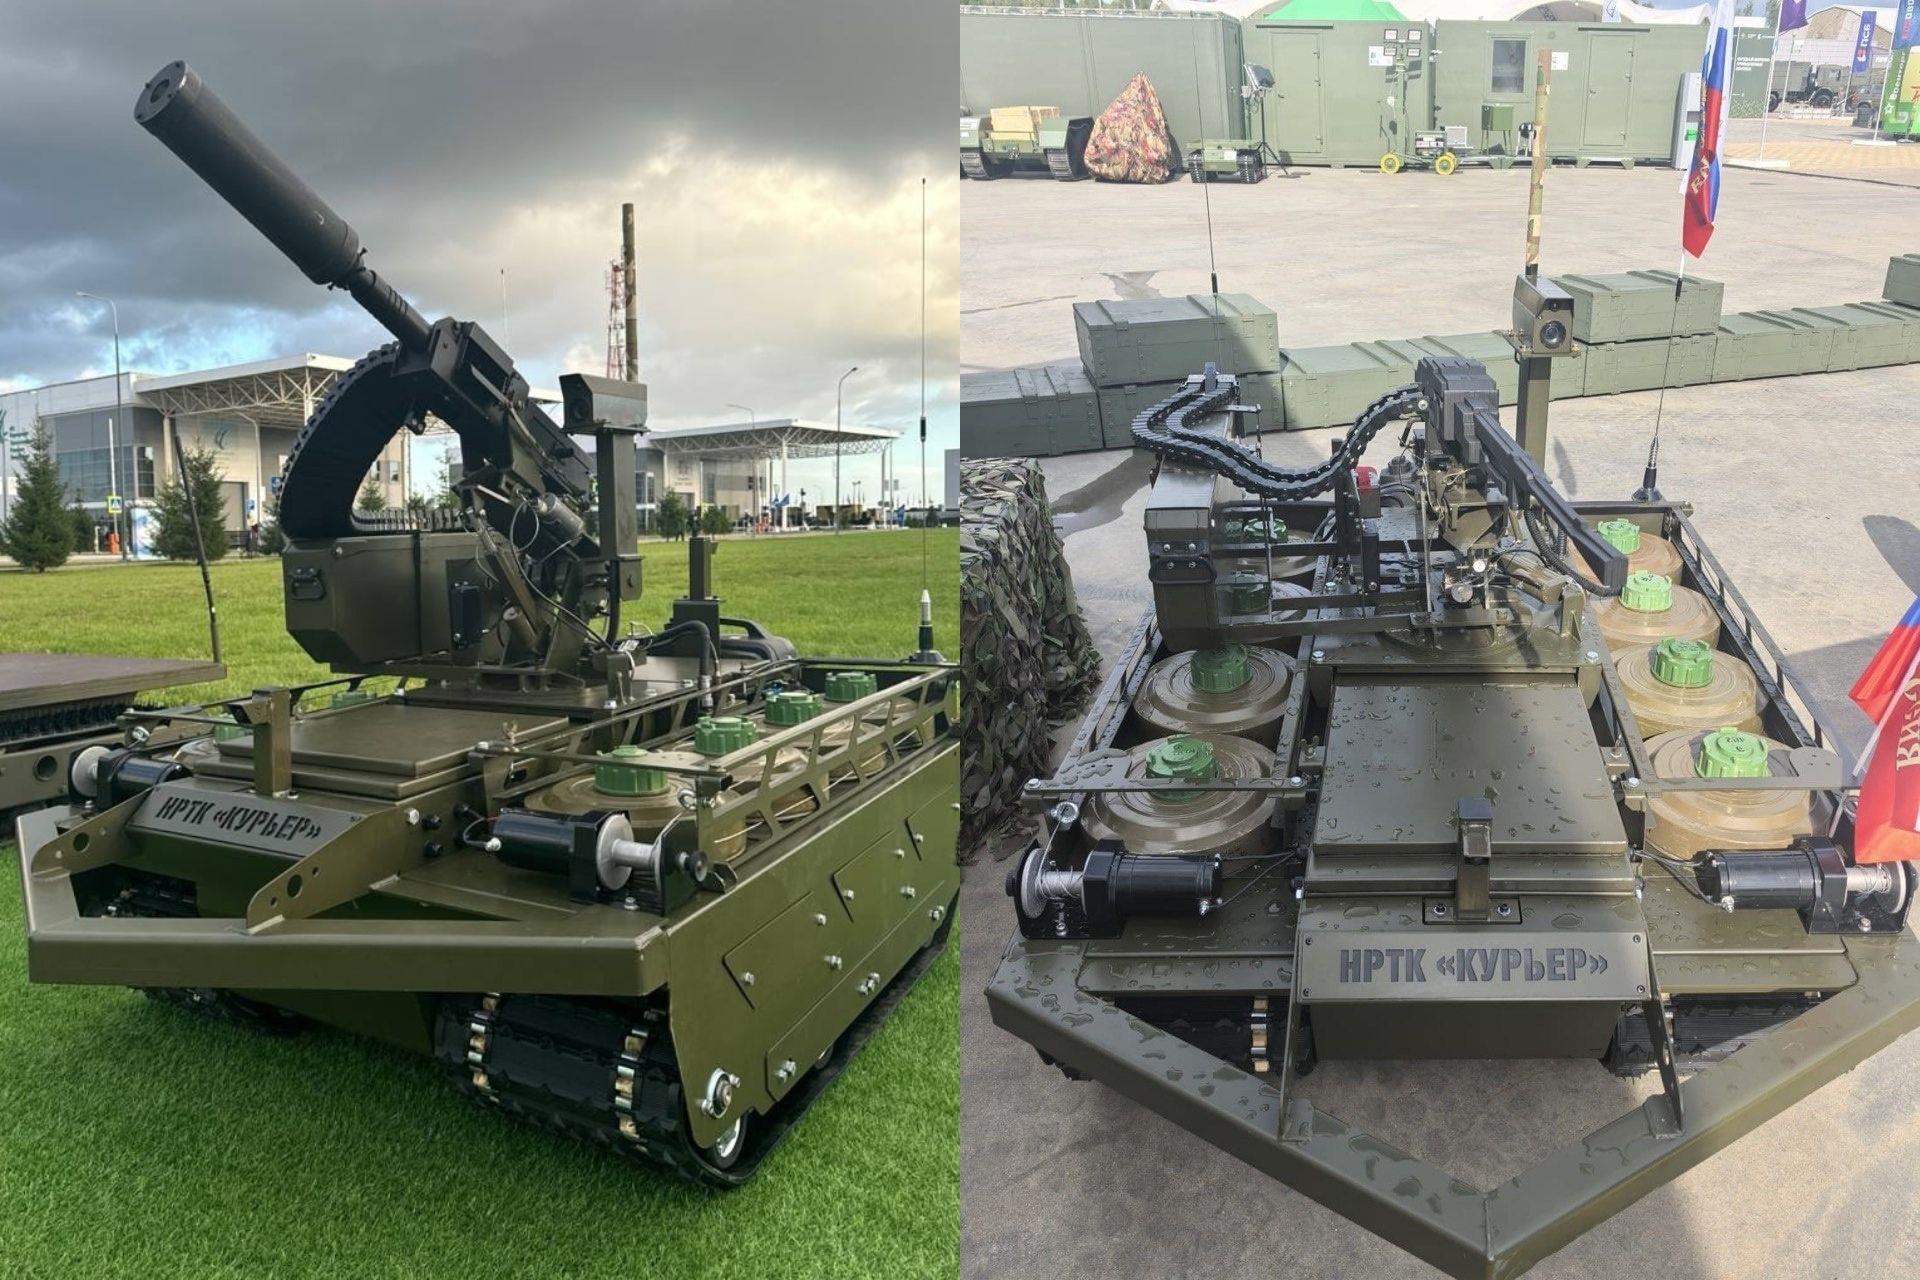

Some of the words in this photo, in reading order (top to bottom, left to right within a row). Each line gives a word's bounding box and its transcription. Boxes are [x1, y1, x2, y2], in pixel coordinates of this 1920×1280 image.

[155, 796, 215, 824] НРТК
[213, 805, 322, 841] «КУРЬЕР»
[1339, 948, 1427, 983] НРТК
[1436, 947, 1608, 983] «КУРЬЕР»
